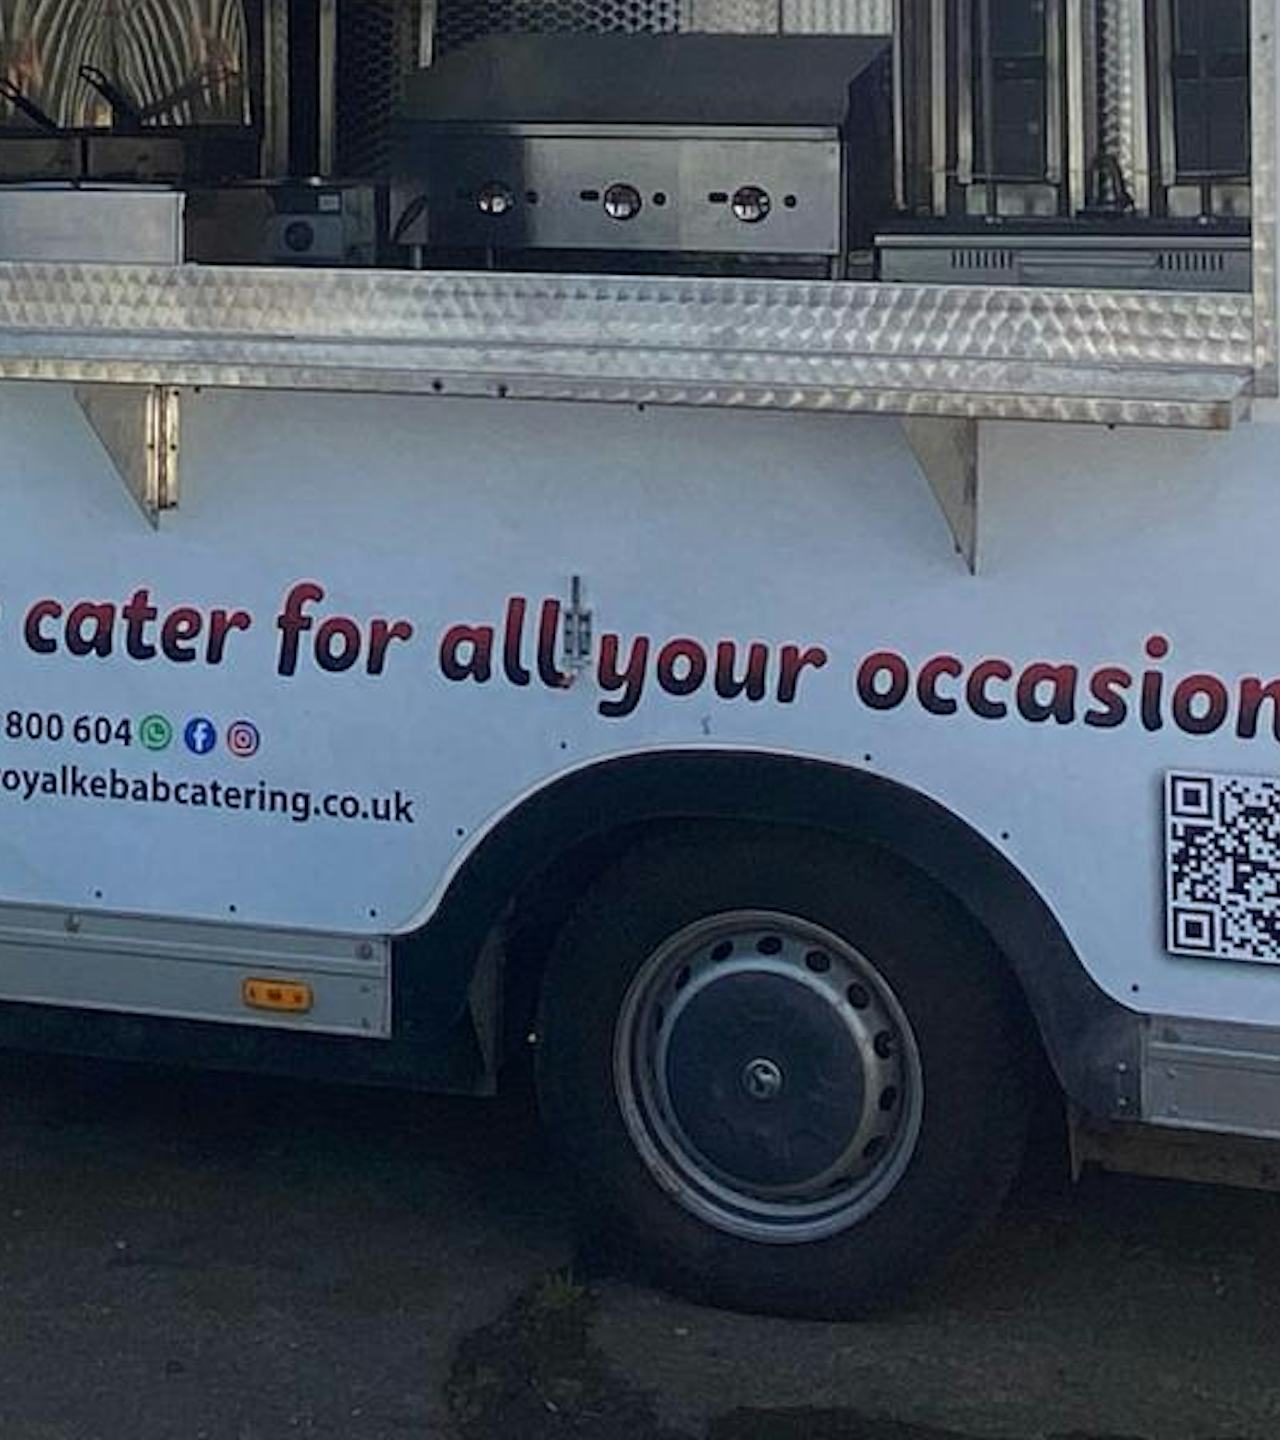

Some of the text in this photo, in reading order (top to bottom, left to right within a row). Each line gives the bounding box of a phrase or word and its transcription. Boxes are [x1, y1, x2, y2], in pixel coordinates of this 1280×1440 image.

[23, 586, 252, 665] cater
[275, 581, 412, 676] for
[438, 594, 573, 689] all
[596, 632, 827, 718] your
[6, 711, 64, 742] 800
[72, 716, 132, 746] 604
